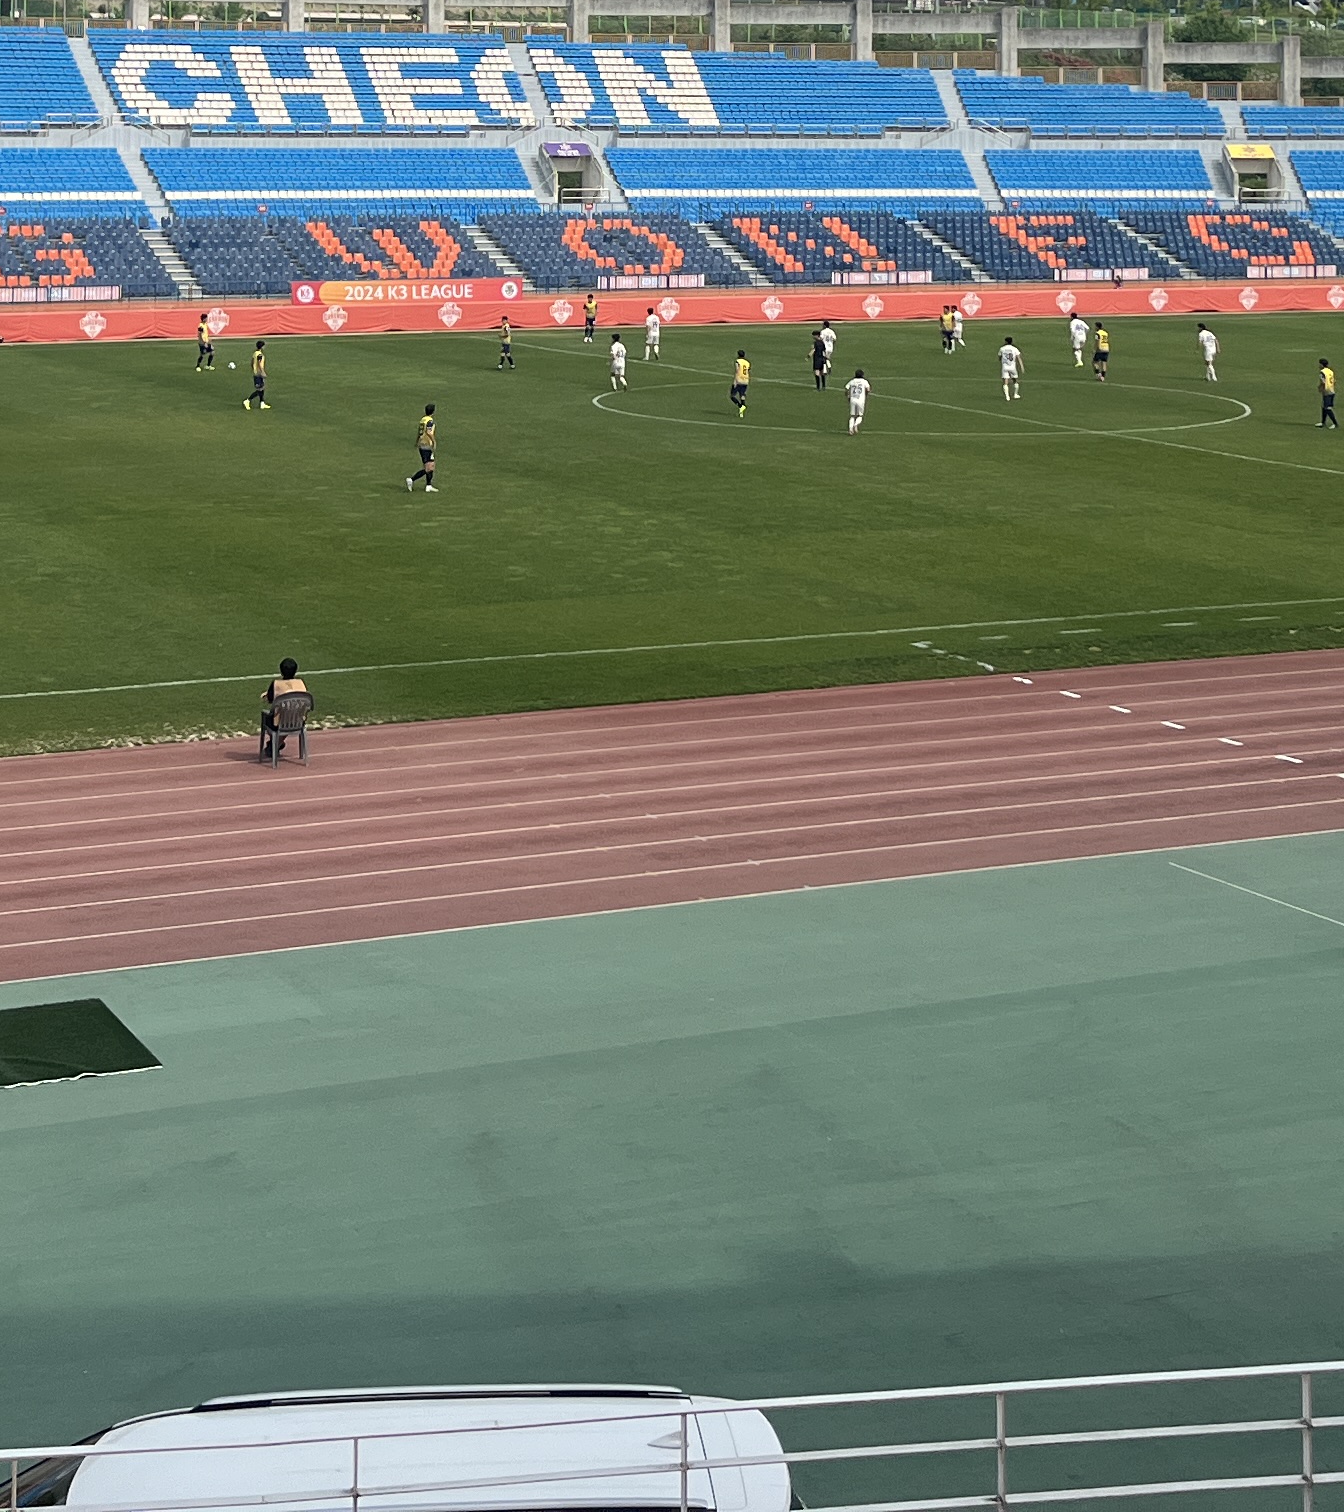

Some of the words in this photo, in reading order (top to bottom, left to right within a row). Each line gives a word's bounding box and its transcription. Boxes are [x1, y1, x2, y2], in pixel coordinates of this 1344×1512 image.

[344, 285, 384, 301] 2024
[387, 284, 408, 300] K3
[412, 283, 474, 299] LEAGUE
